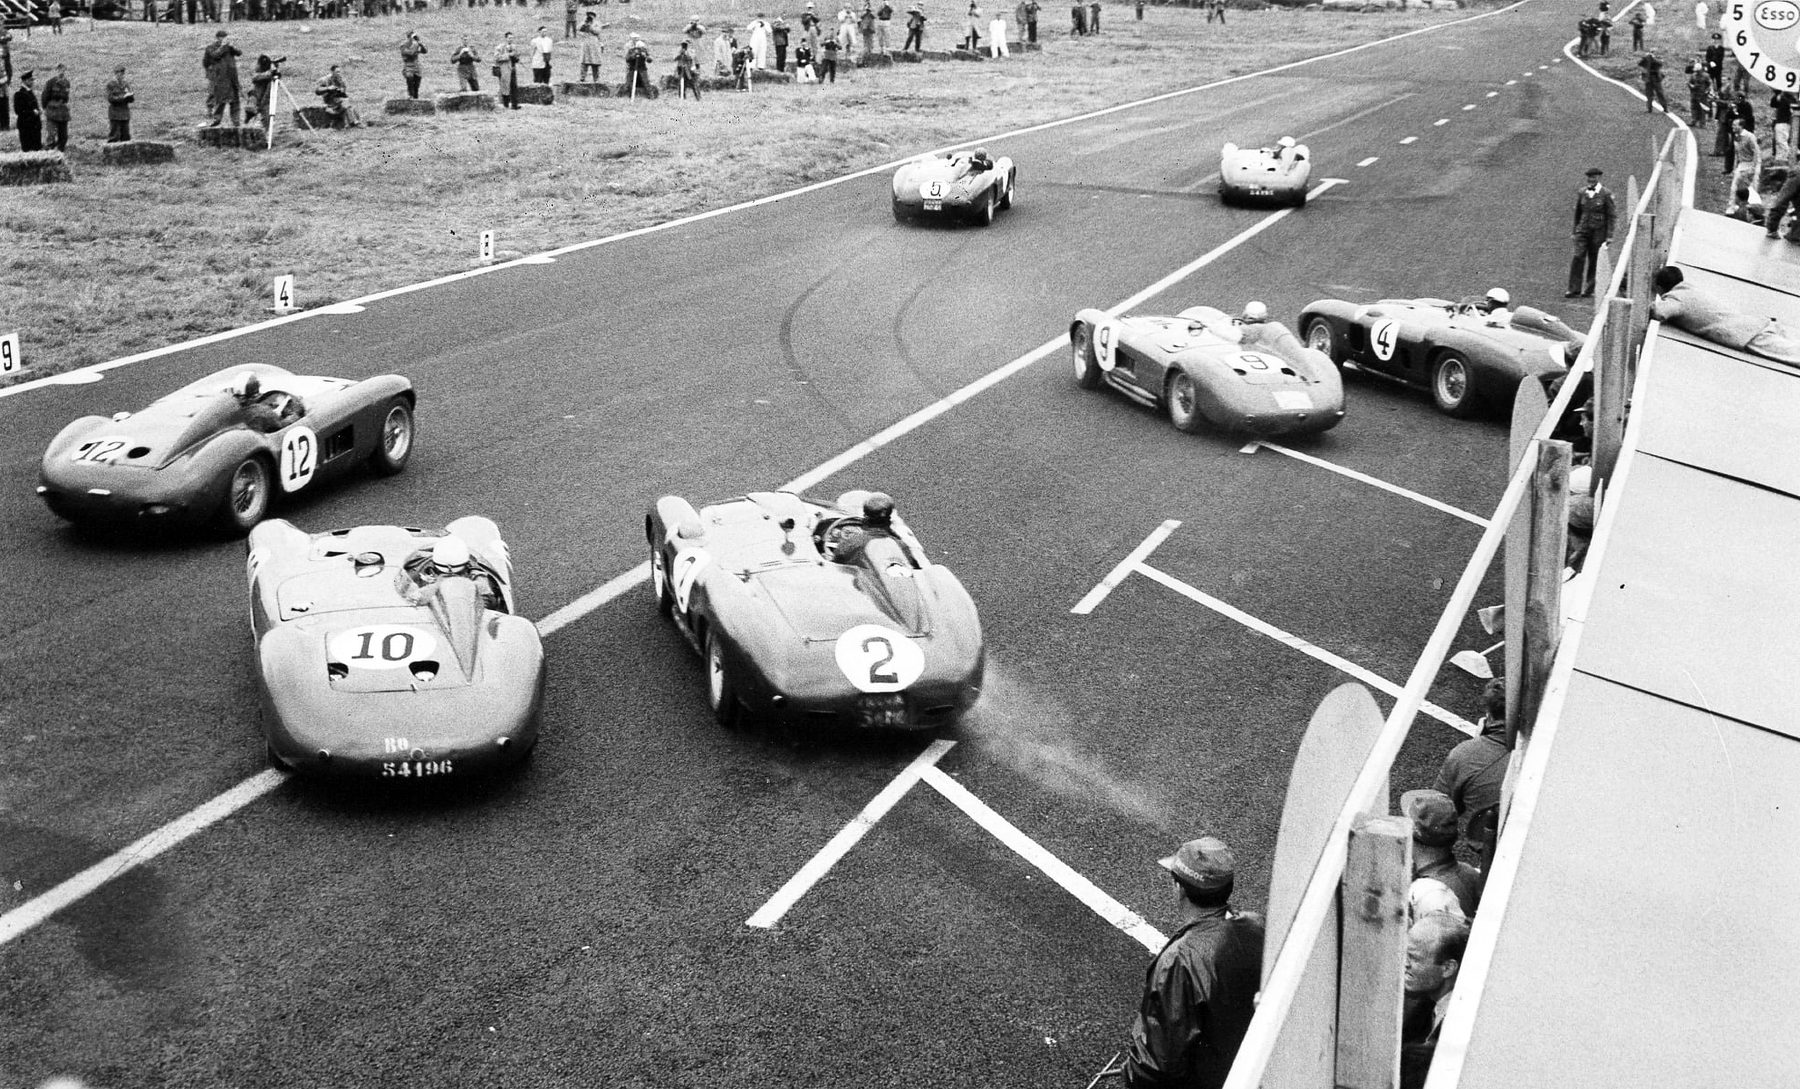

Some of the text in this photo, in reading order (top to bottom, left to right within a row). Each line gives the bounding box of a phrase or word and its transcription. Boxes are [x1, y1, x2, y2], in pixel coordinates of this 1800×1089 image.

[1761, 7, 1795, 20] Esso
[1733, 4, 1796, 88] 5 6 7 8 9
[930, 181, 942, 197] 5
[280, 280, 289, 307] 4
[1100, 326, 1110, 362] 9
[1377, 322, 1392, 356] 4
[2, 340, 13, 371] 9
[1240, 354, 1269, 370] 9
[77, 440, 126, 462] 12
[288, 435, 310, 481] 12
[351, 632, 415, 661] 10
[862, 636, 899, 684] 2
[382, 759, 453, 777] 54196
